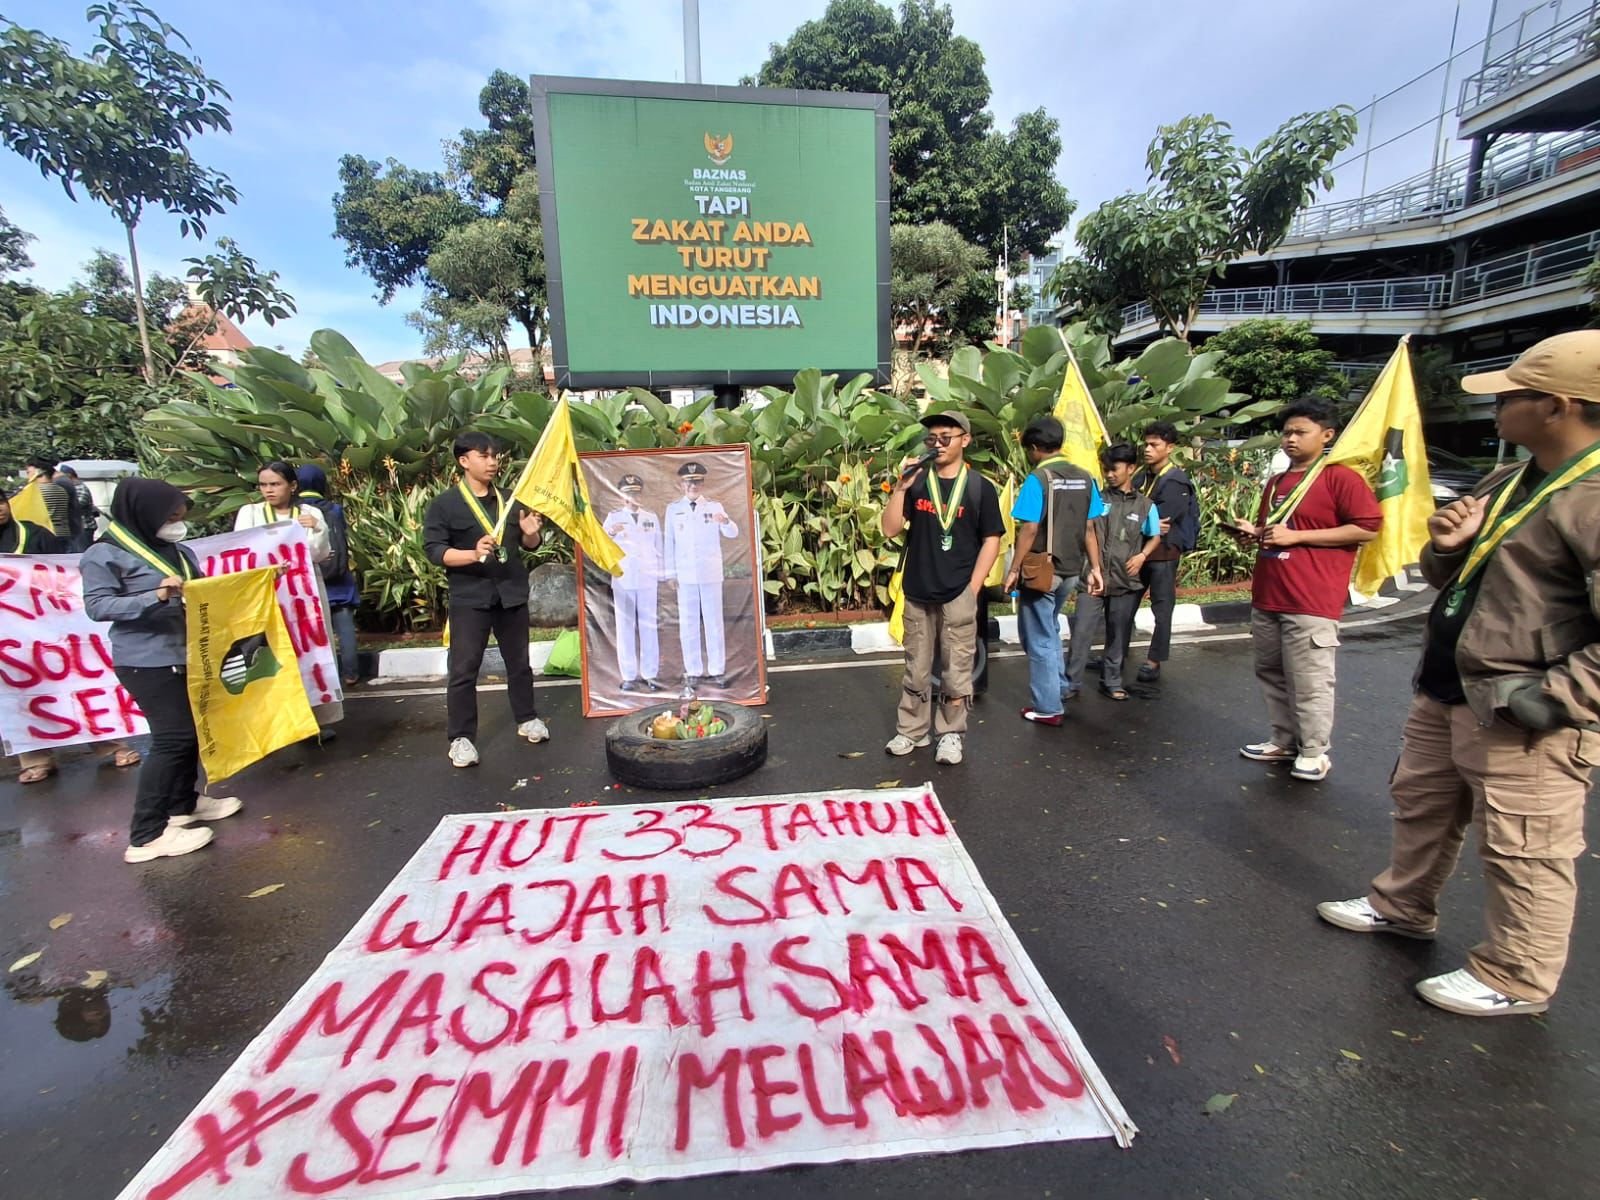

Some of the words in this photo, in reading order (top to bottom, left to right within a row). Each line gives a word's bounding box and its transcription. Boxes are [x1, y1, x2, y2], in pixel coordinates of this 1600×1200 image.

[693, 168, 746, 180] BAZNAS
[694, 195, 748, 215] TAPI
[631, 218, 726, 241] ZAKAT
[733, 220, 812, 243] ANDA
[677, 246, 769, 268] TURUT
[627, 274, 819, 297] MENGUATKAN
[649, 304, 801, 326] INDONESIA
[437, 812, 609, 880] HUT
[600, 803, 742, 860] 33
[734, 792, 949, 852] TAHUN
[365, 873, 669, 953] WAJAH
[702, 856, 965, 927] SAMA
[264, 941, 755, 1074] MASALAH
[770, 925, 1029, 1023] SAMA
[673, 1012, 1087, 1152] MELAWAN
